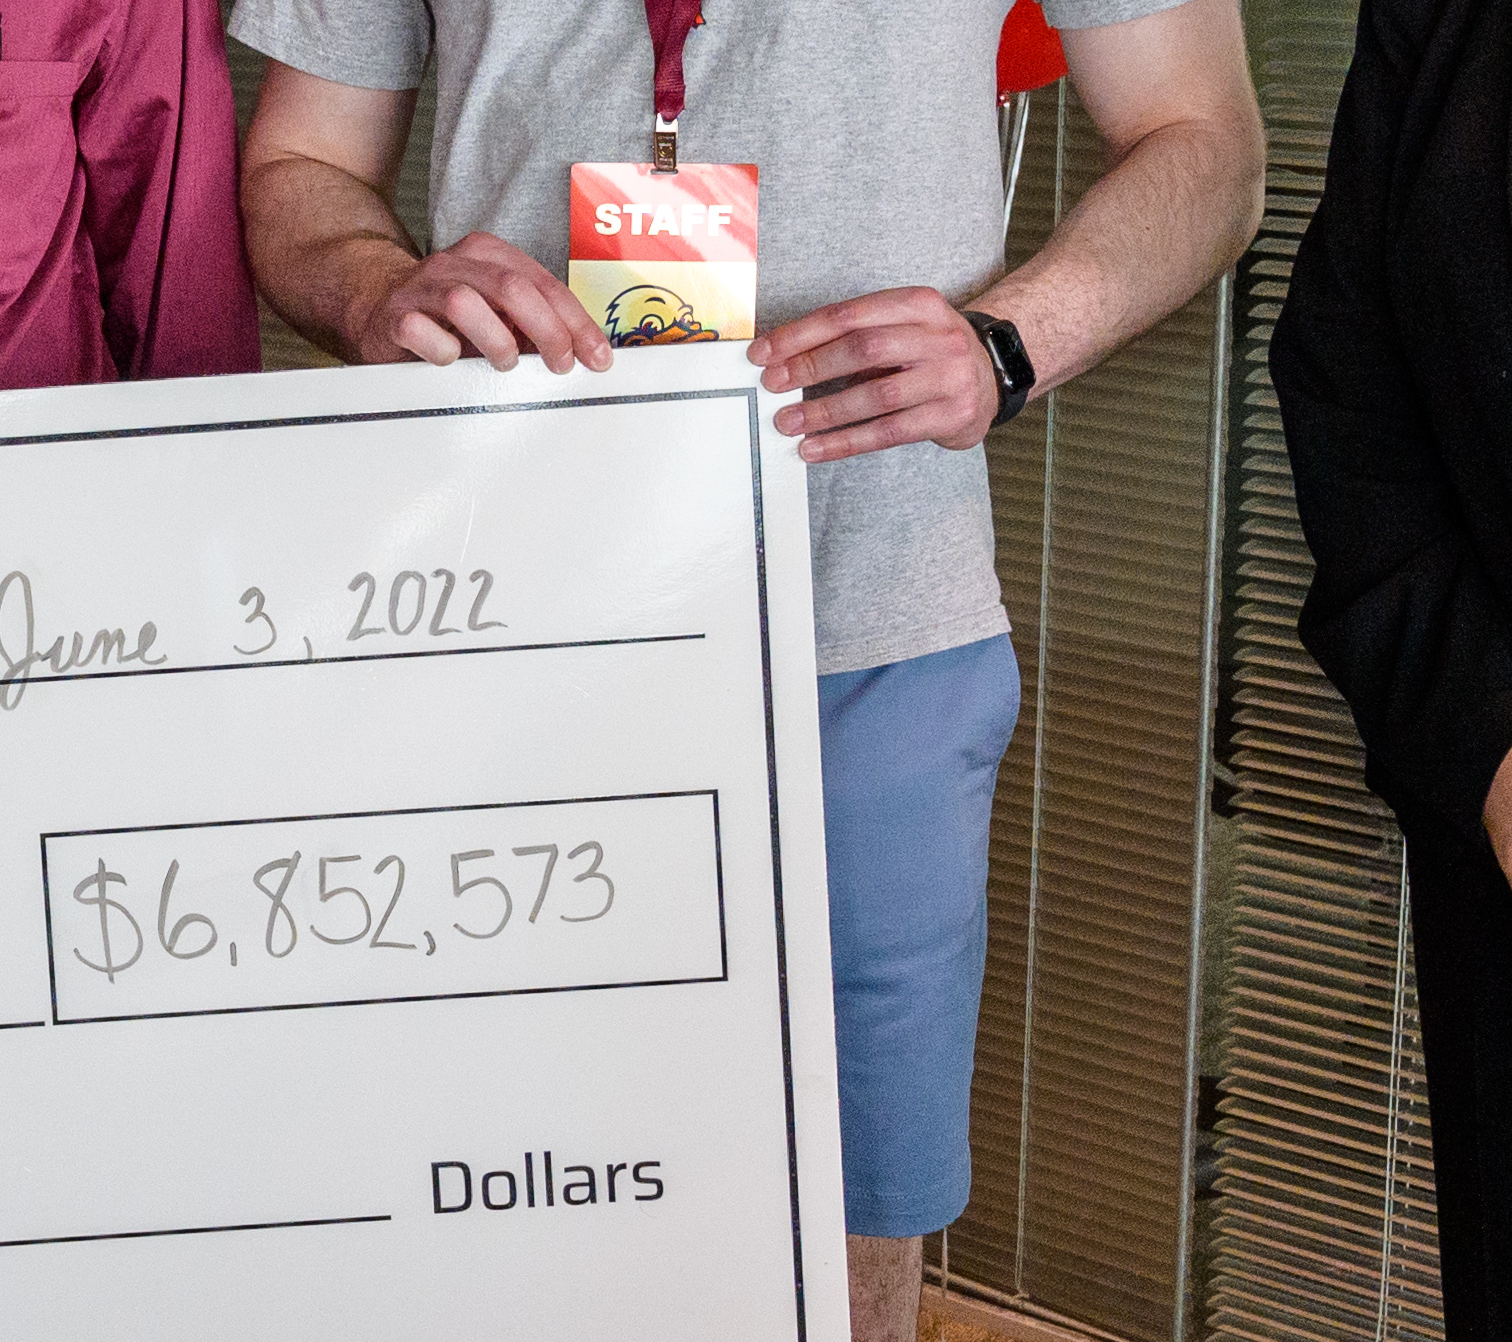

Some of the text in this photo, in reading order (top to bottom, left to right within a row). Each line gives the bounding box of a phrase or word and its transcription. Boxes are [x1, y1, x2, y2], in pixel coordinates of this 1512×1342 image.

[594, 204, 734, 237] STAFF
[347, 568, 508, 644] 2022
[73, 838, 616, 984] $6,852,573
[430, 1152, 667, 1217] Dollars
